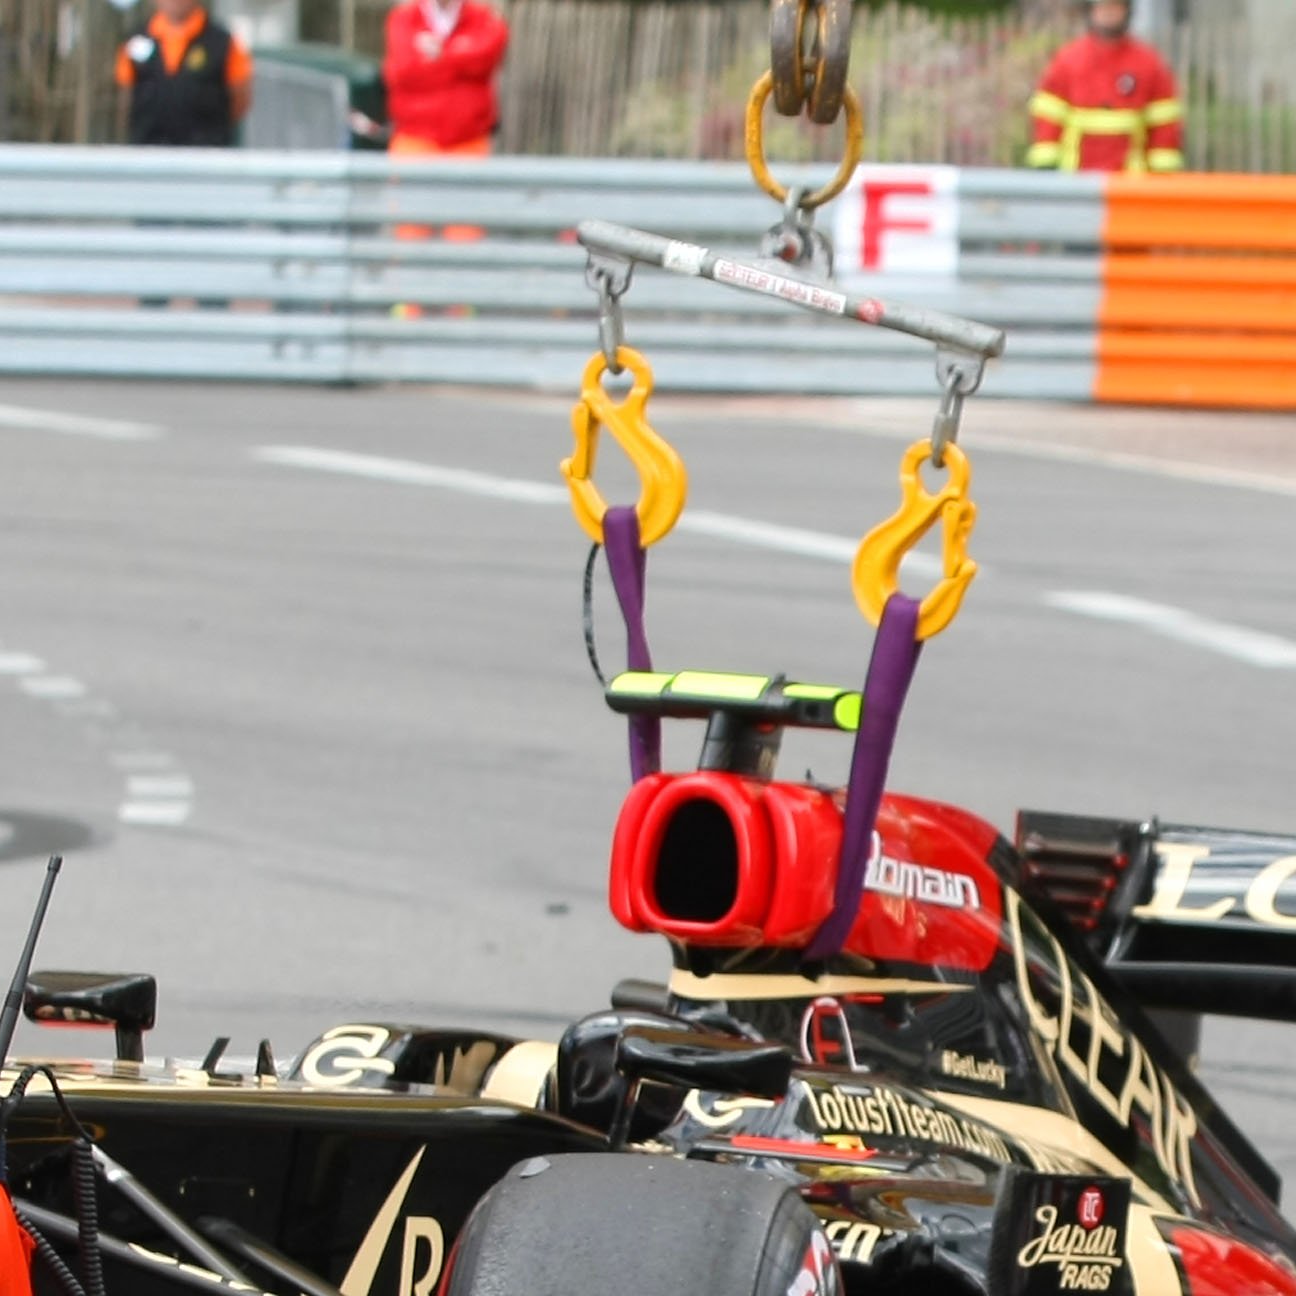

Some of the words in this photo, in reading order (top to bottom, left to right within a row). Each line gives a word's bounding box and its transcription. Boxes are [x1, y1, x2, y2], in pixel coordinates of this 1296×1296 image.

[861, 181, 932, 270] F
[802, 1080, 1012, 1163] lotusf1team.com
[1017, 1205, 1119, 1271] Japan
[1059, 1263, 1112, 1290] RAGS
